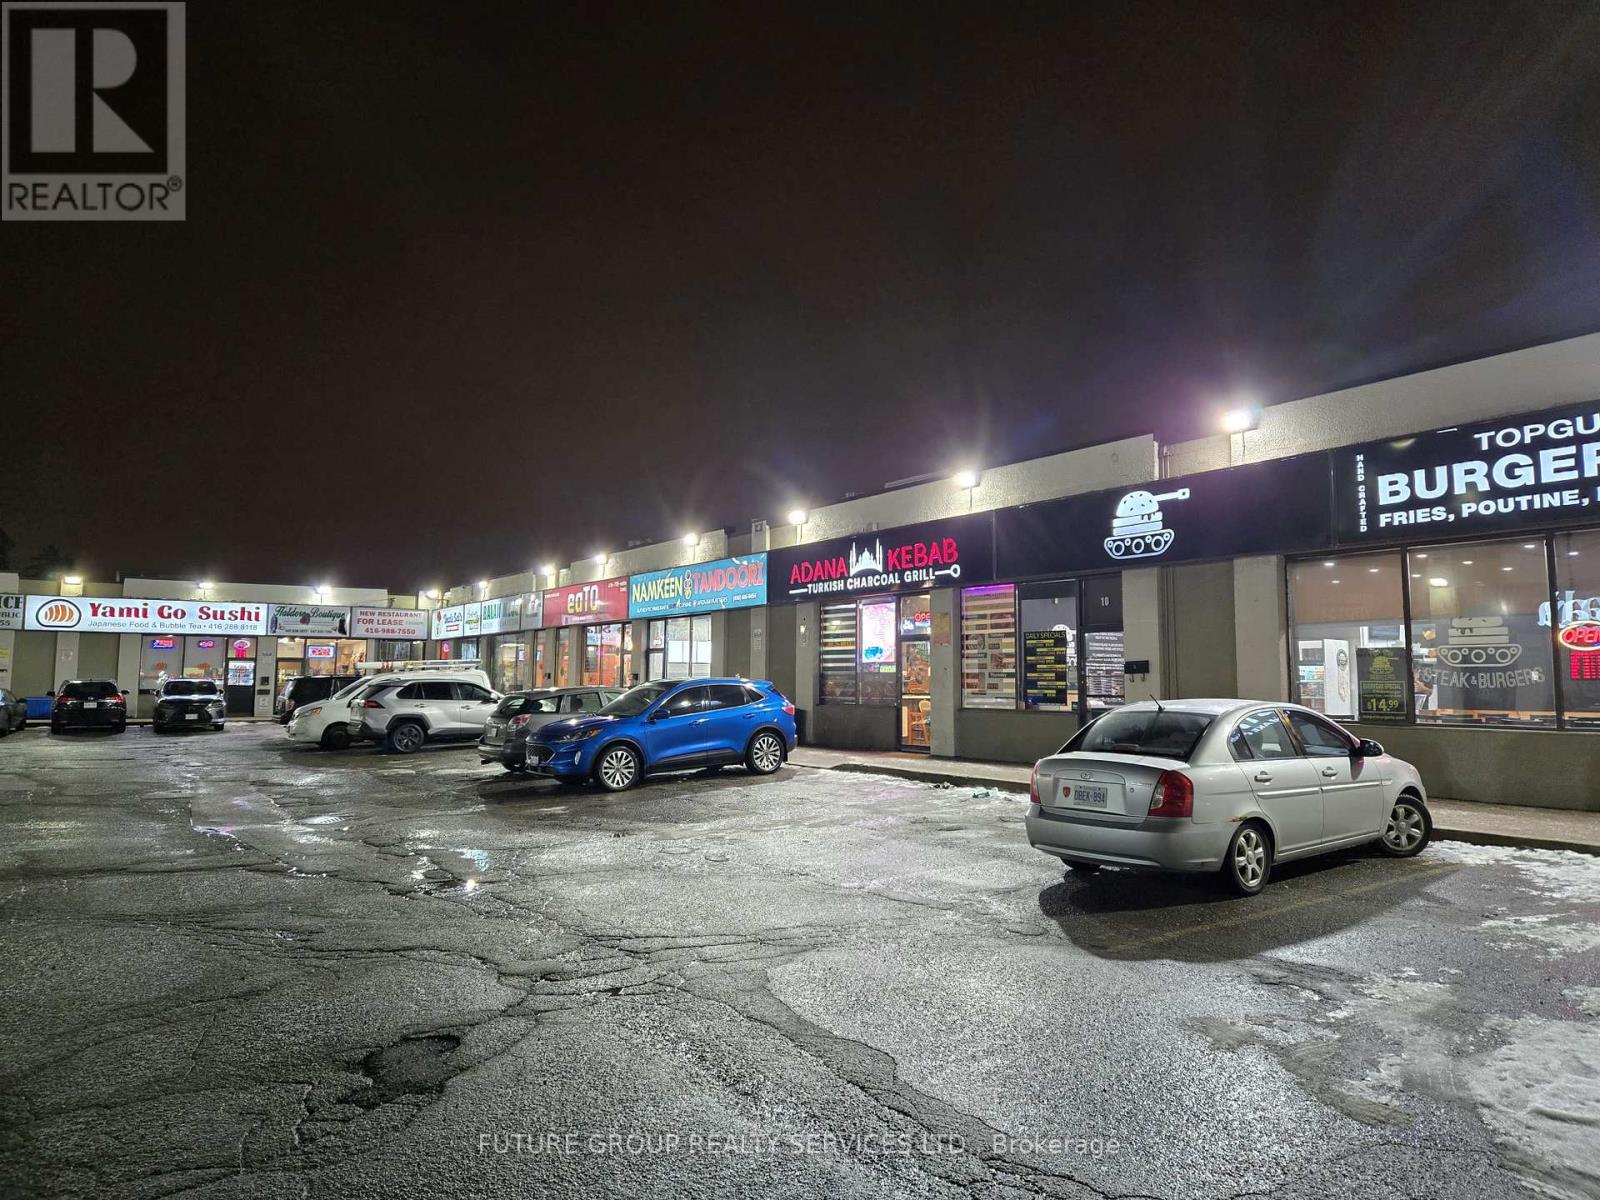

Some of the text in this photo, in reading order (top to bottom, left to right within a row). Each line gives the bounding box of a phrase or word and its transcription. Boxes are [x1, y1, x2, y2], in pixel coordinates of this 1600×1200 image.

[1355, 454, 1365, 482] HAND
[1358, 485, 1368, 533] CRAFTED
[1379, 506, 1455, 527] FRIES,
[1461, 489, 1590, 518] POUTINE,
[789, 538, 959, 584] ADANA KEBAB
[807, 568, 936, 594] TURKISH CHARCOAL GRILL
[89, 602, 261, 622] Yami Go Sushi
[1100, 596, 1110, 606] 10
[88, 619, 126, 628] Japanese
[129, 620, 150, 628] Food
[160, 621, 186, 629] Bubble
[356, 618, 374, 626] FOR
[1040, 631, 1066, 639] SPECIALS
[1423, 668, 1470, 689] STEAK
[1470, 674, 1479, 686] &
[1478, 666, 1546, 689] BURGERS
